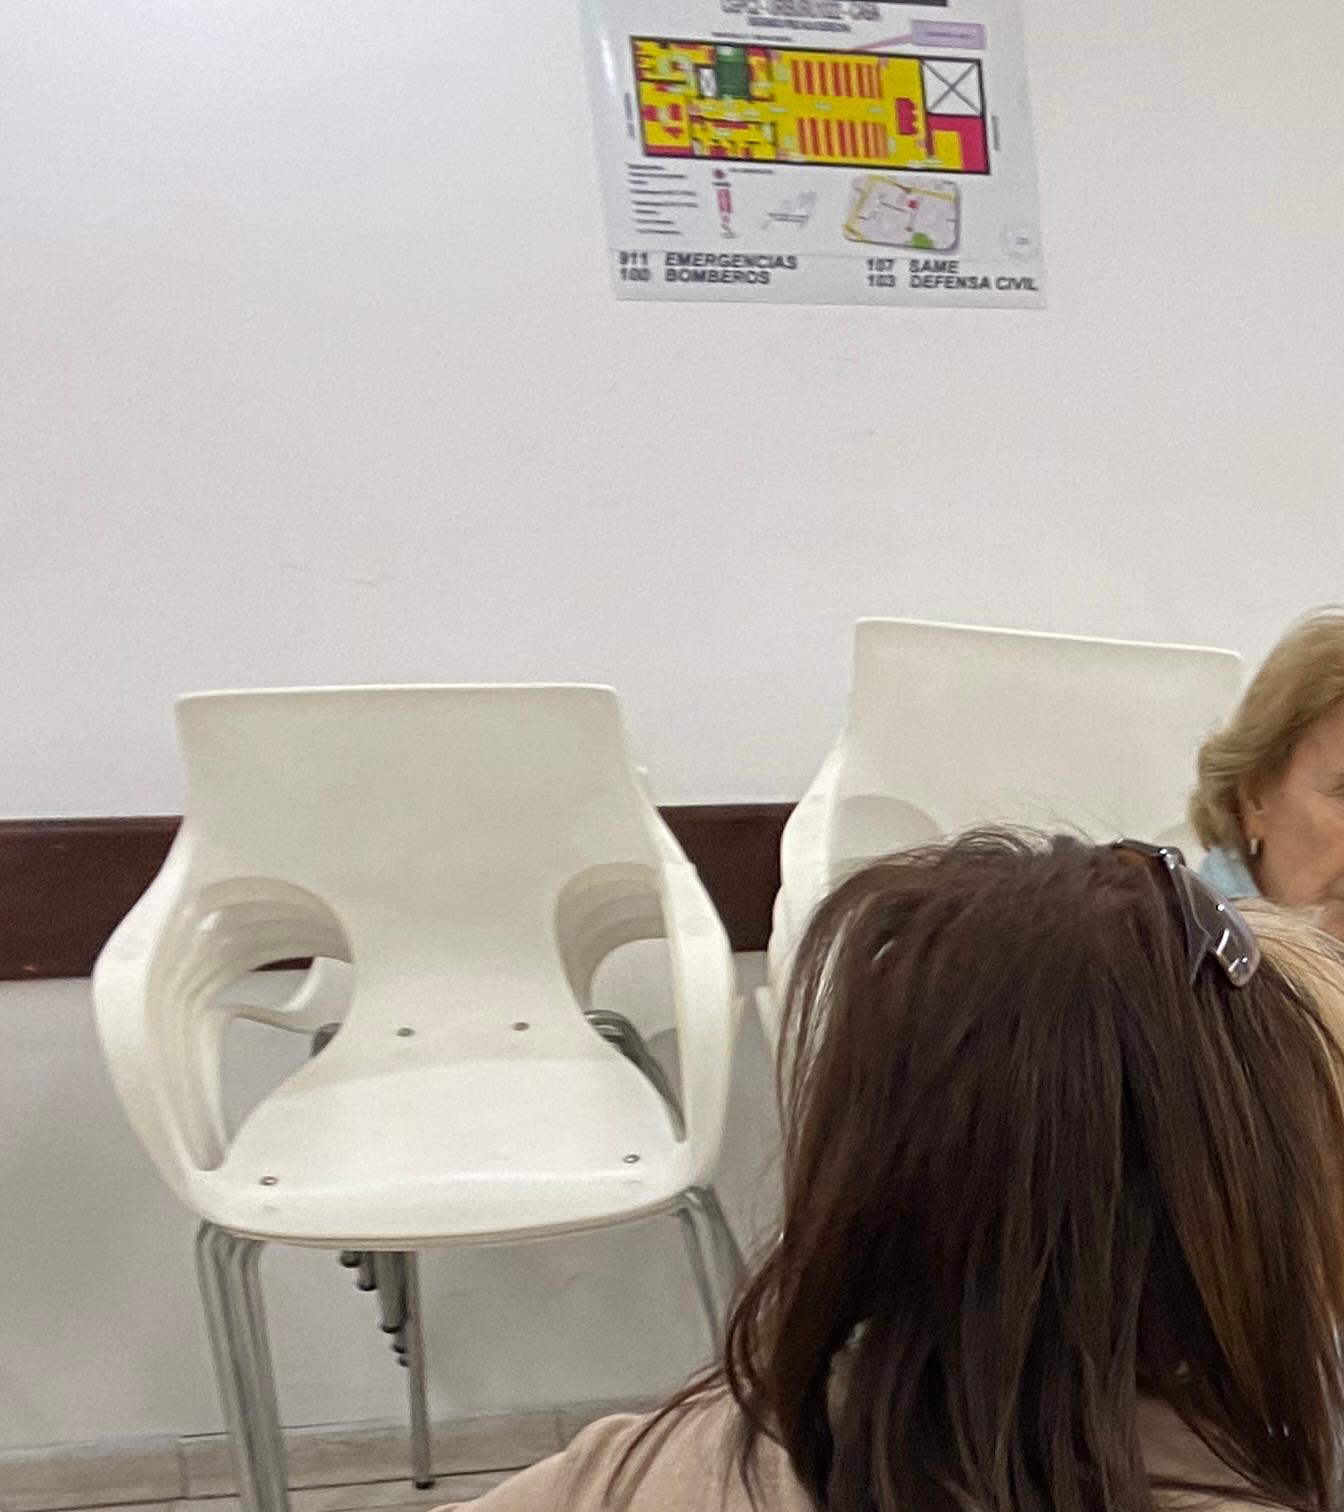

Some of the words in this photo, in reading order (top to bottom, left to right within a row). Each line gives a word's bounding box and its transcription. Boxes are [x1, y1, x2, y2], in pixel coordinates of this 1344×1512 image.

[619, 251, 649, 266] 911
[665, 252, 798, 270] EMERGENCIAS
[866, 258, 895, 272] 107
[909, 259, 960, 274] SAME
[620, 267, 651, 282] 100
[665, 269, 770, 285] BOMBEROS
[867, 274, 896, 288] 103
[909, 274, 991, 290] DEFENSA
[995, 276, 1039, 292] CIVIL
